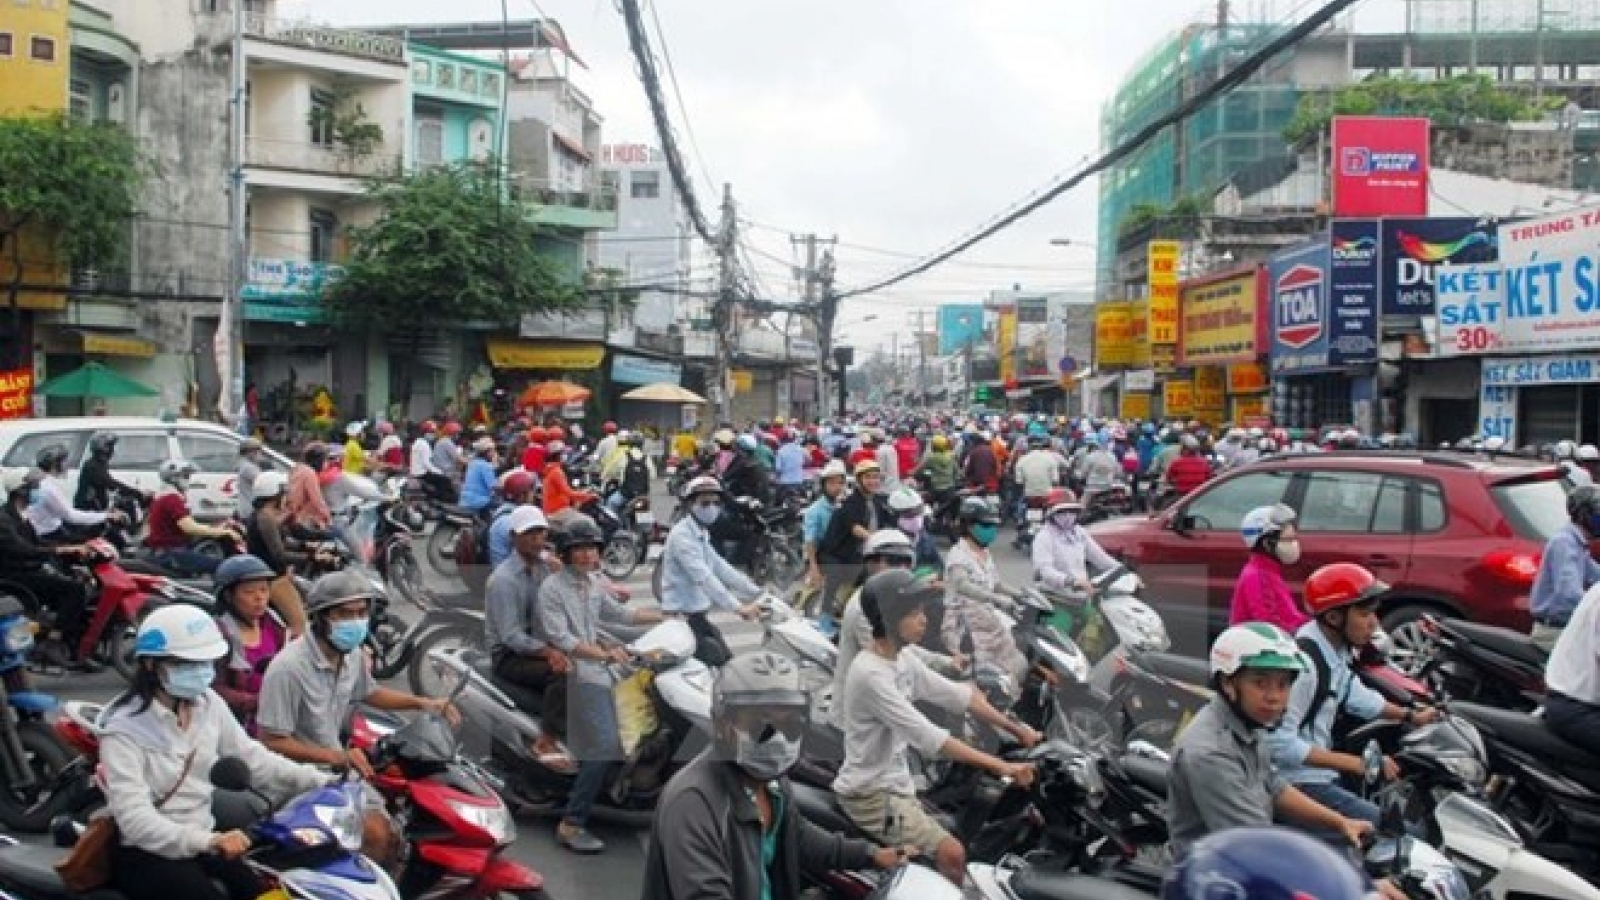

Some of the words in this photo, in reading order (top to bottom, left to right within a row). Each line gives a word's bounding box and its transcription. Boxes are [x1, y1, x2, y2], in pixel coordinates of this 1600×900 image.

[1510, 217, 1574, 241] TRUNG
[1439, 265, 1502, 293] KÉT
[1505, 250, 1562, 319] KÉT
[1280, 287, 1317, 325] TOA
